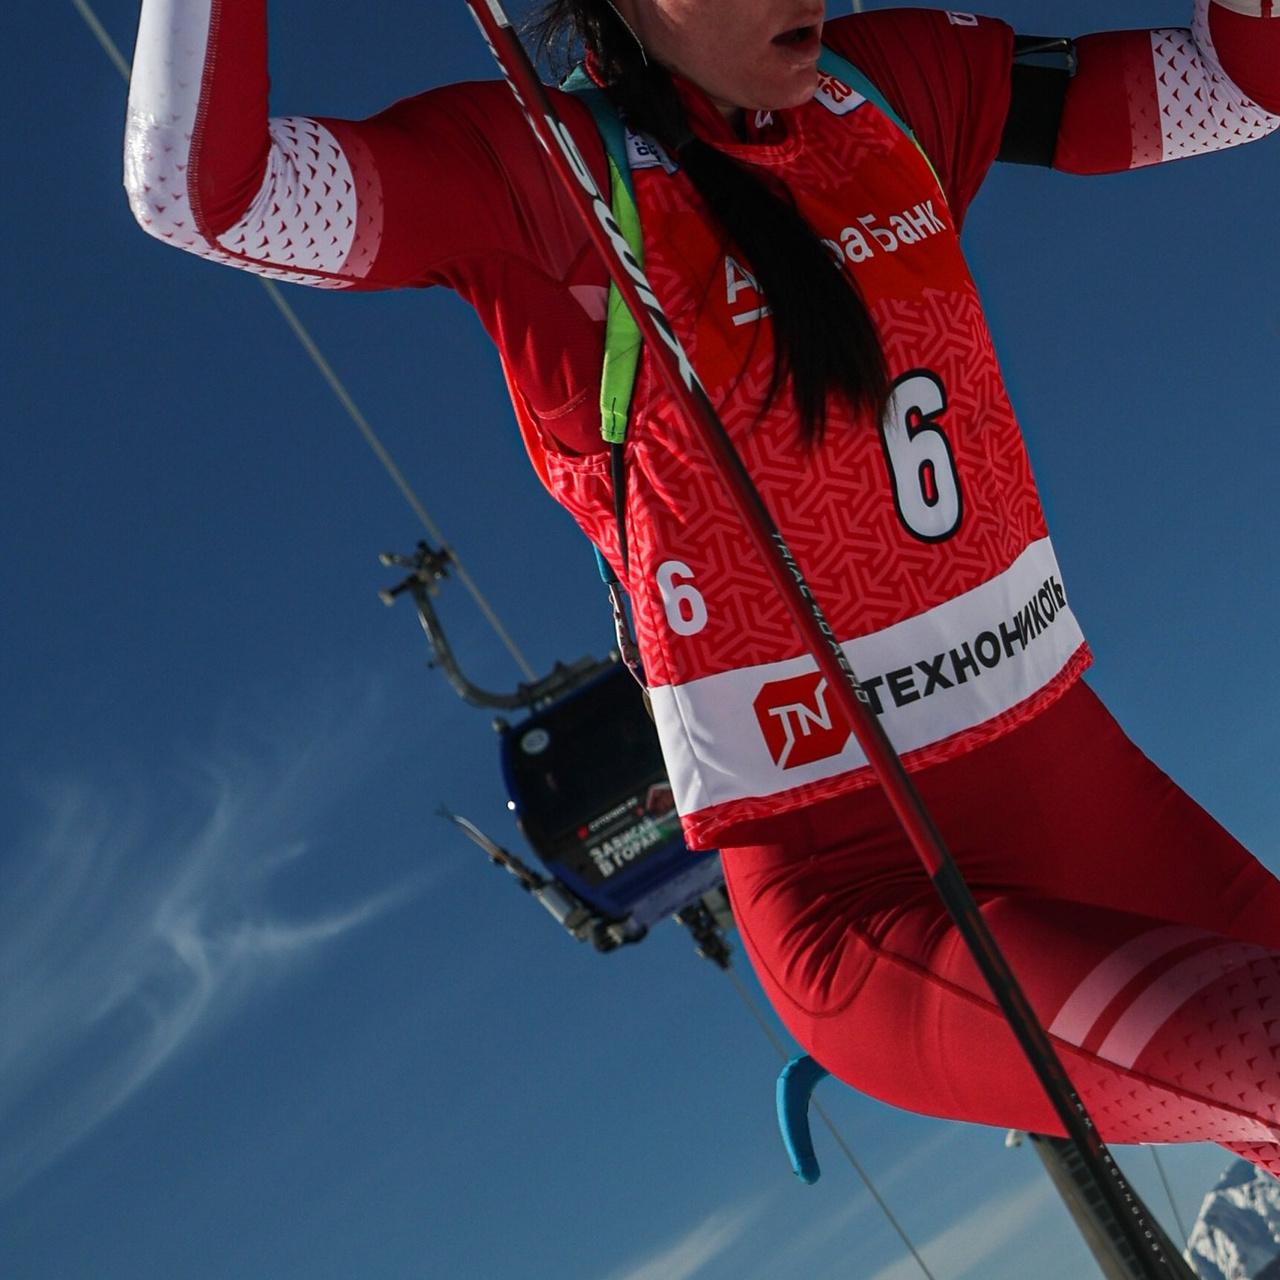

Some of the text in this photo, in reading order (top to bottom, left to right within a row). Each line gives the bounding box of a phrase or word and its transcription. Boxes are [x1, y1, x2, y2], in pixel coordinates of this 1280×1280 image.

[884, 369, 963, 545] 6
[656, 561, 708, 637] 6
[772, 531, 811, 598] TRIAC
[828, 640, 869, 703] AERO
